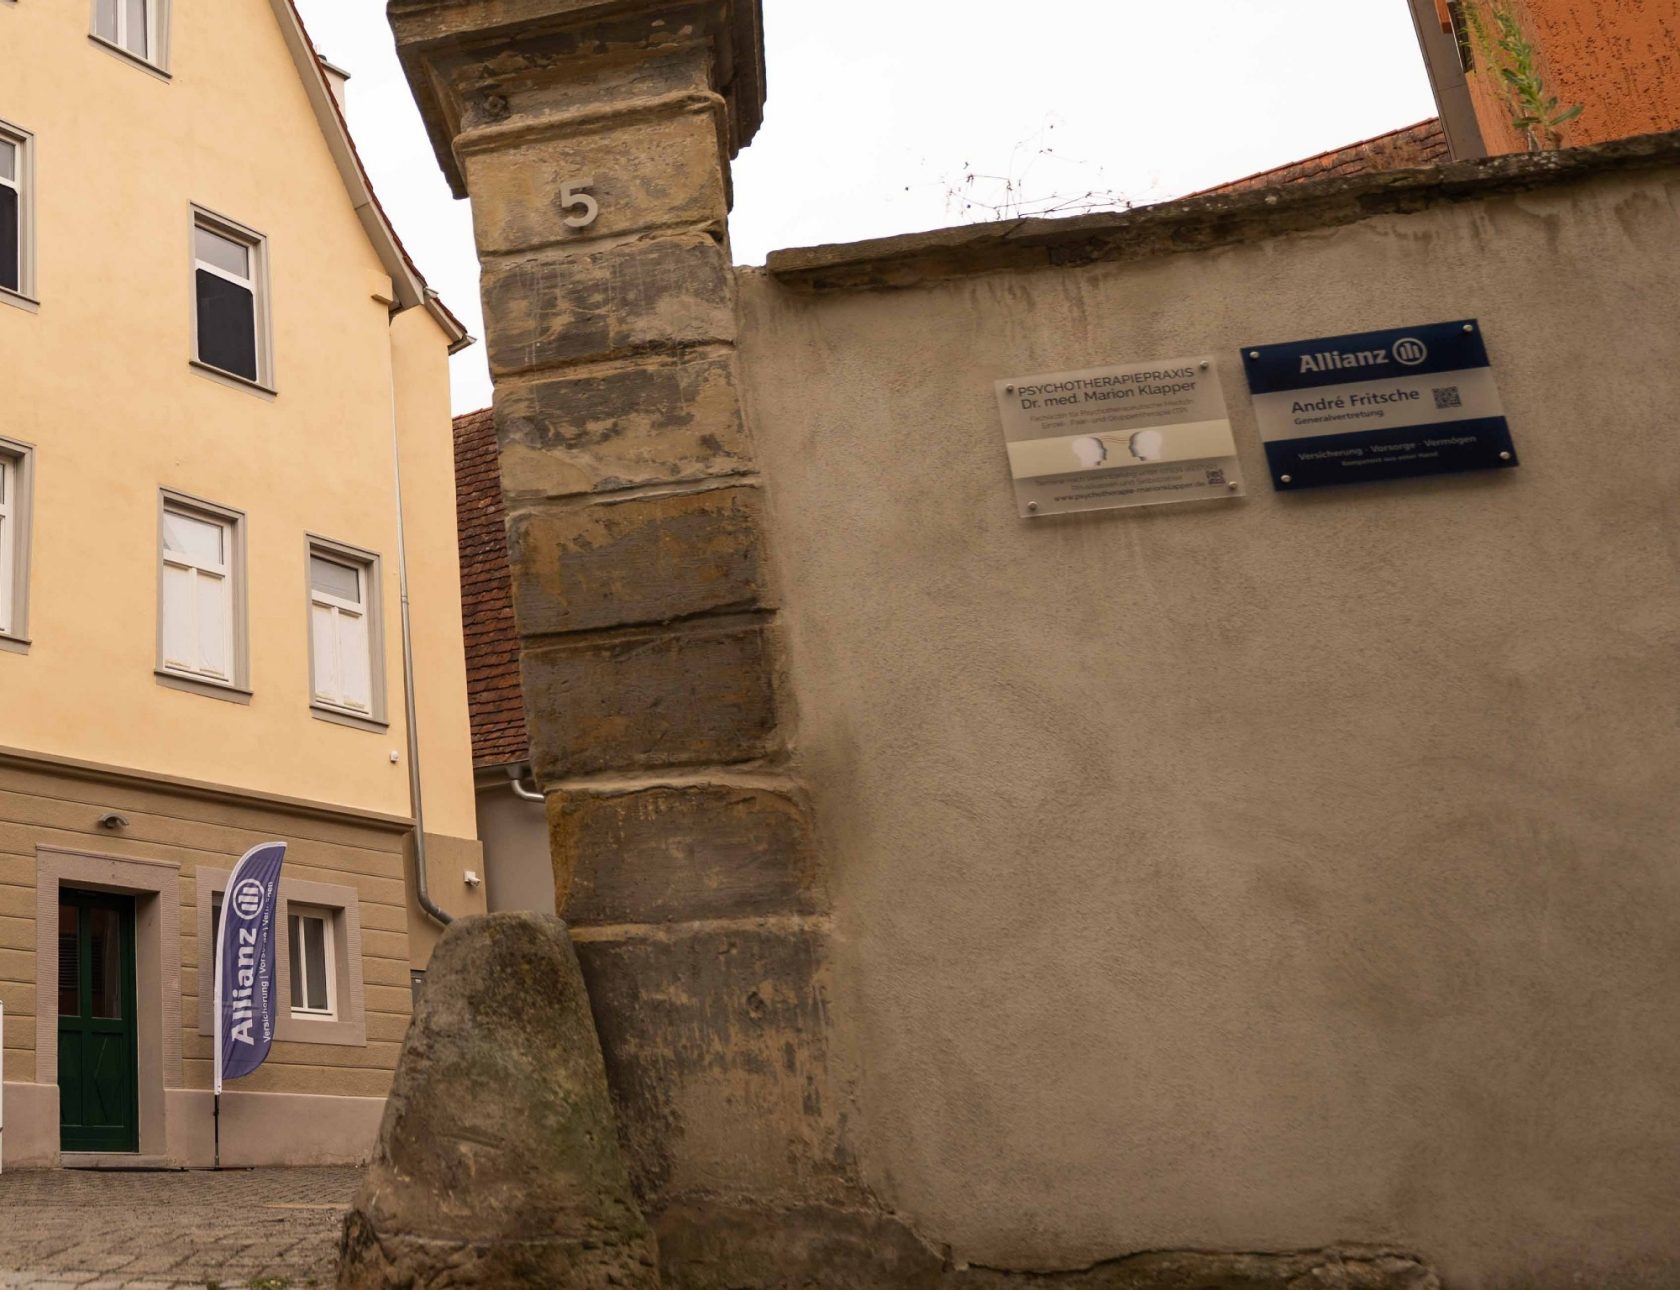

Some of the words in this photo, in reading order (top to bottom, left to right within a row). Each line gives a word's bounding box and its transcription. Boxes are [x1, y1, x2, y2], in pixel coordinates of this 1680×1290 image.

[559, 177, 599, 227] 5
[1299, 348, 1389, 374] Allianz
[1017, 367, 1195, 397] PSYCHOTHERAPIEPRAXIS
[1021, 398, 1041, 410] Dr.
[1044, 393, 1080, 407] med.
[1084, 387, 1135, 402] Marion
[1137, 382, 1196, 397] Klapper
[1291, 395, 1345, 414] André
[1350, 389, 1420, 408] Fritsche
[1294, 408, 1384, 425] Generalvertretung
[1298, 447, 1363, 461] Versicherung
[1370, 442, 1417, 453] Vorsorge
[1423, 435, 1478, 447] Vermögen
[231, 928, 257, 1046] Allianz
[261, 981, 272, 1043] Versicherung
